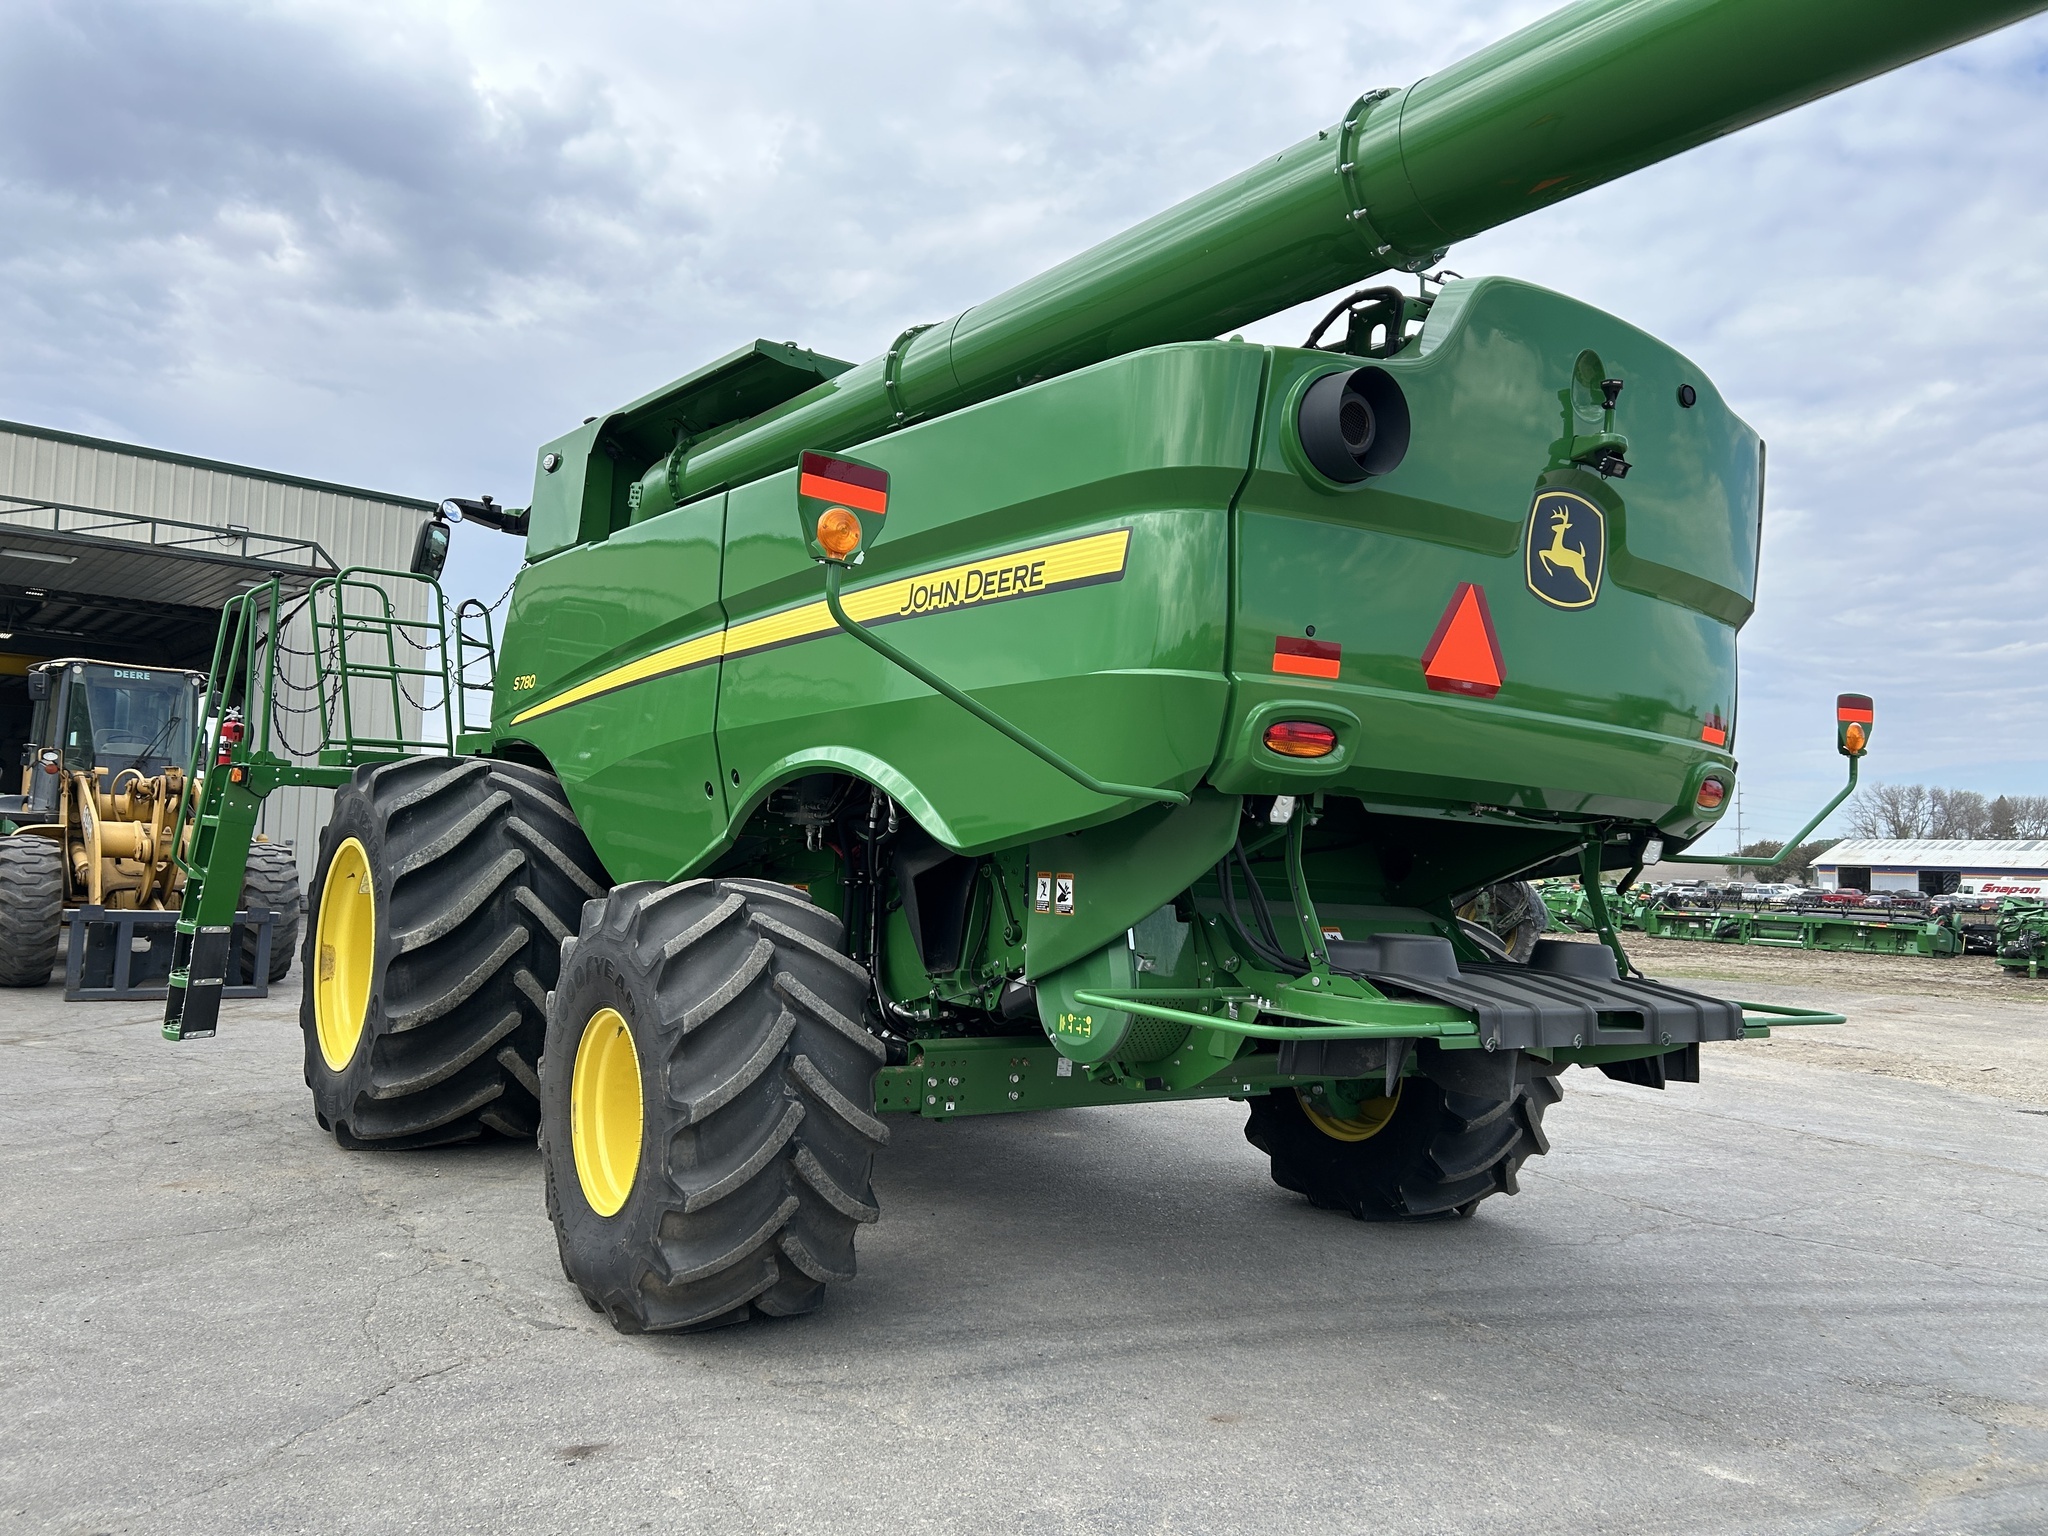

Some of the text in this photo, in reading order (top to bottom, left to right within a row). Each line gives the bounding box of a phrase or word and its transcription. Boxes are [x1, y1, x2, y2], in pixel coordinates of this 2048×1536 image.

[900, 560, 1046, 612] JOHN DEERE
[114, 669, 151, 681] DEERE
[513, 674, 536, 691] S780
[1980, 883, 2041, 895] Snap-on
